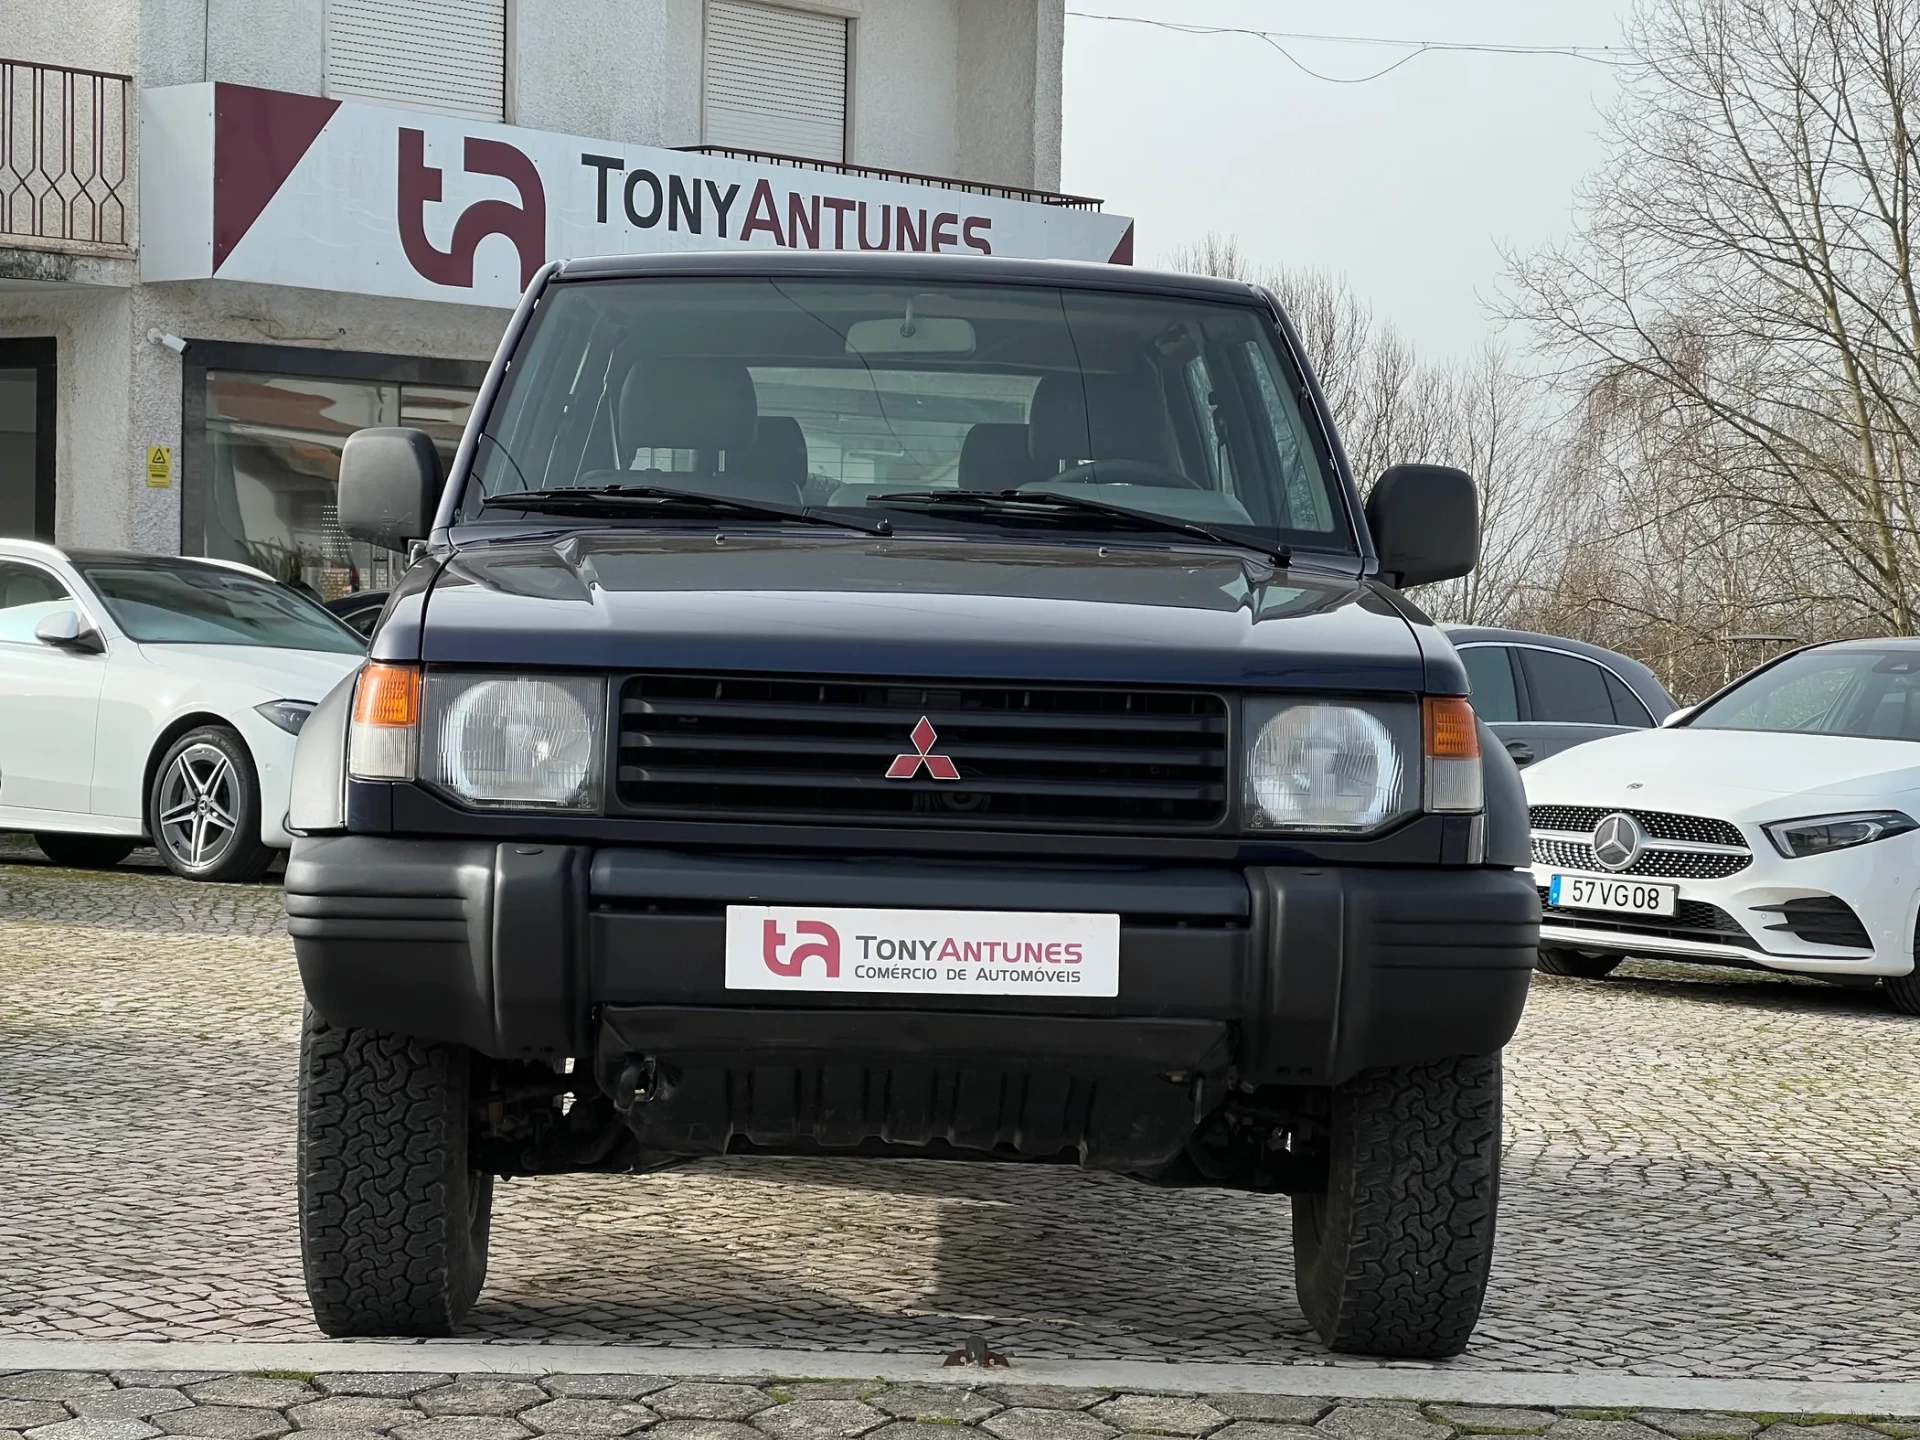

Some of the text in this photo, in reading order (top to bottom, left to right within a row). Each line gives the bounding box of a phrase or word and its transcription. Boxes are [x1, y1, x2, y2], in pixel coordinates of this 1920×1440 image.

[854, 964, 1082, 983] COMÉRCIO DE AUTOMÓVEIS
